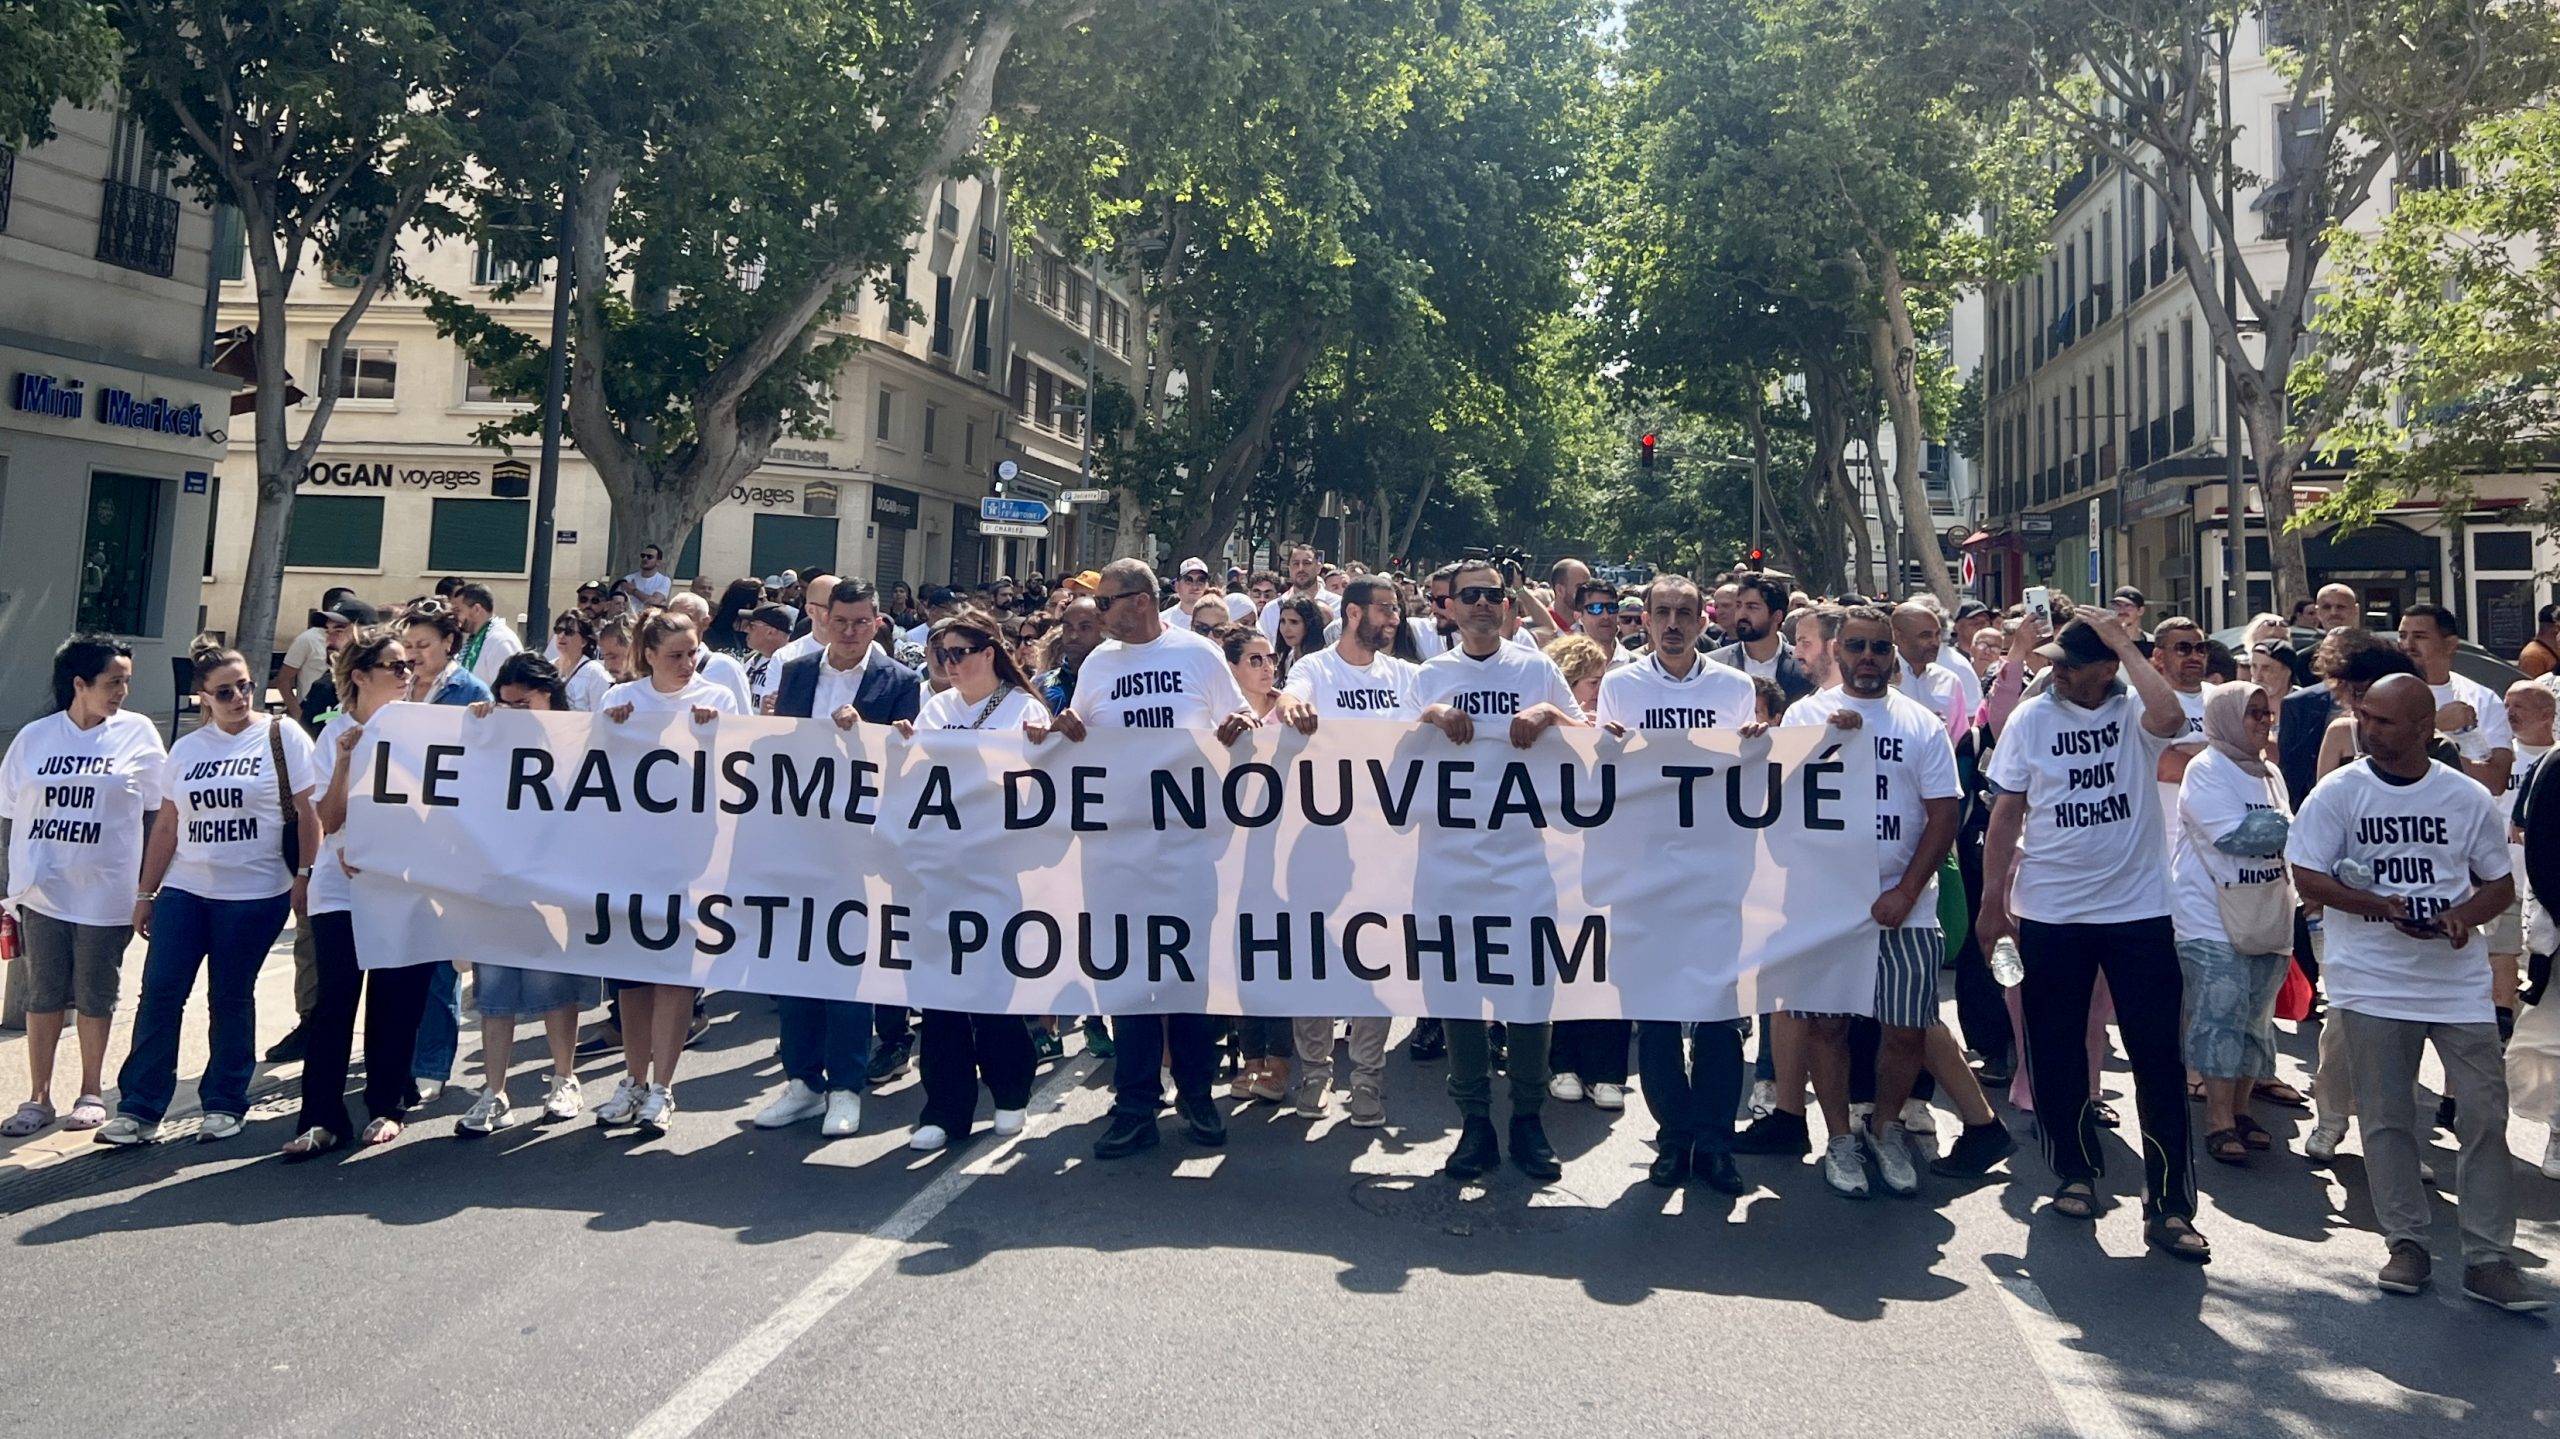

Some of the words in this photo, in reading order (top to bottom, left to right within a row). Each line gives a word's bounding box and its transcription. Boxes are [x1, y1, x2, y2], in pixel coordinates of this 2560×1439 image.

[18, 373, 84, 418] Mini
[98, 387, 203, 438] Market
[399, 469, 481, 490] voyages
[730, 485, 795, 507] oyages
[1001, 502, 1006, 510] A
[1009, 502, 1014, 510] 7
[994, 525, 1023, 534] CHARLES
[1110, 671, 1184, 701] JUSTICE
[1336, 689, 1400, 711] JUSTICE
[1453, 691, 1520, 715] JUSTICE
[1123, 706, 1174, 728] POUR
[1639, 707, 1717, 729] JUSTICE
[37, 755, 115, 776] JUSTICE
[184, 757, 262, 781] JUSTICE
[45, 785, 96, 809] POUR
[372, 740, 465, 807] LE
[506, 747, 879, 825] RACISME
[907, 765, 962, 831] A
[1003, 765, 1109, 831] DE
[1150, 759, 1617, 831] NOUVEAU
[1661, 743, 1845, 831] TUÉ
[189, 787, 243, 811] POUR
[2054, 793, 2131, 828] HICHEM
[188, 817, 258, 843] HICHEM
[2356, 816, 2449, 845] JUSTICE
[2373, 857, 2436, 884] POUR
[585, 892, 913, 971] JUSTICE
[948, 910, 1196, 984] POUR
[1239, 910, 1608, 987] HICHEM
